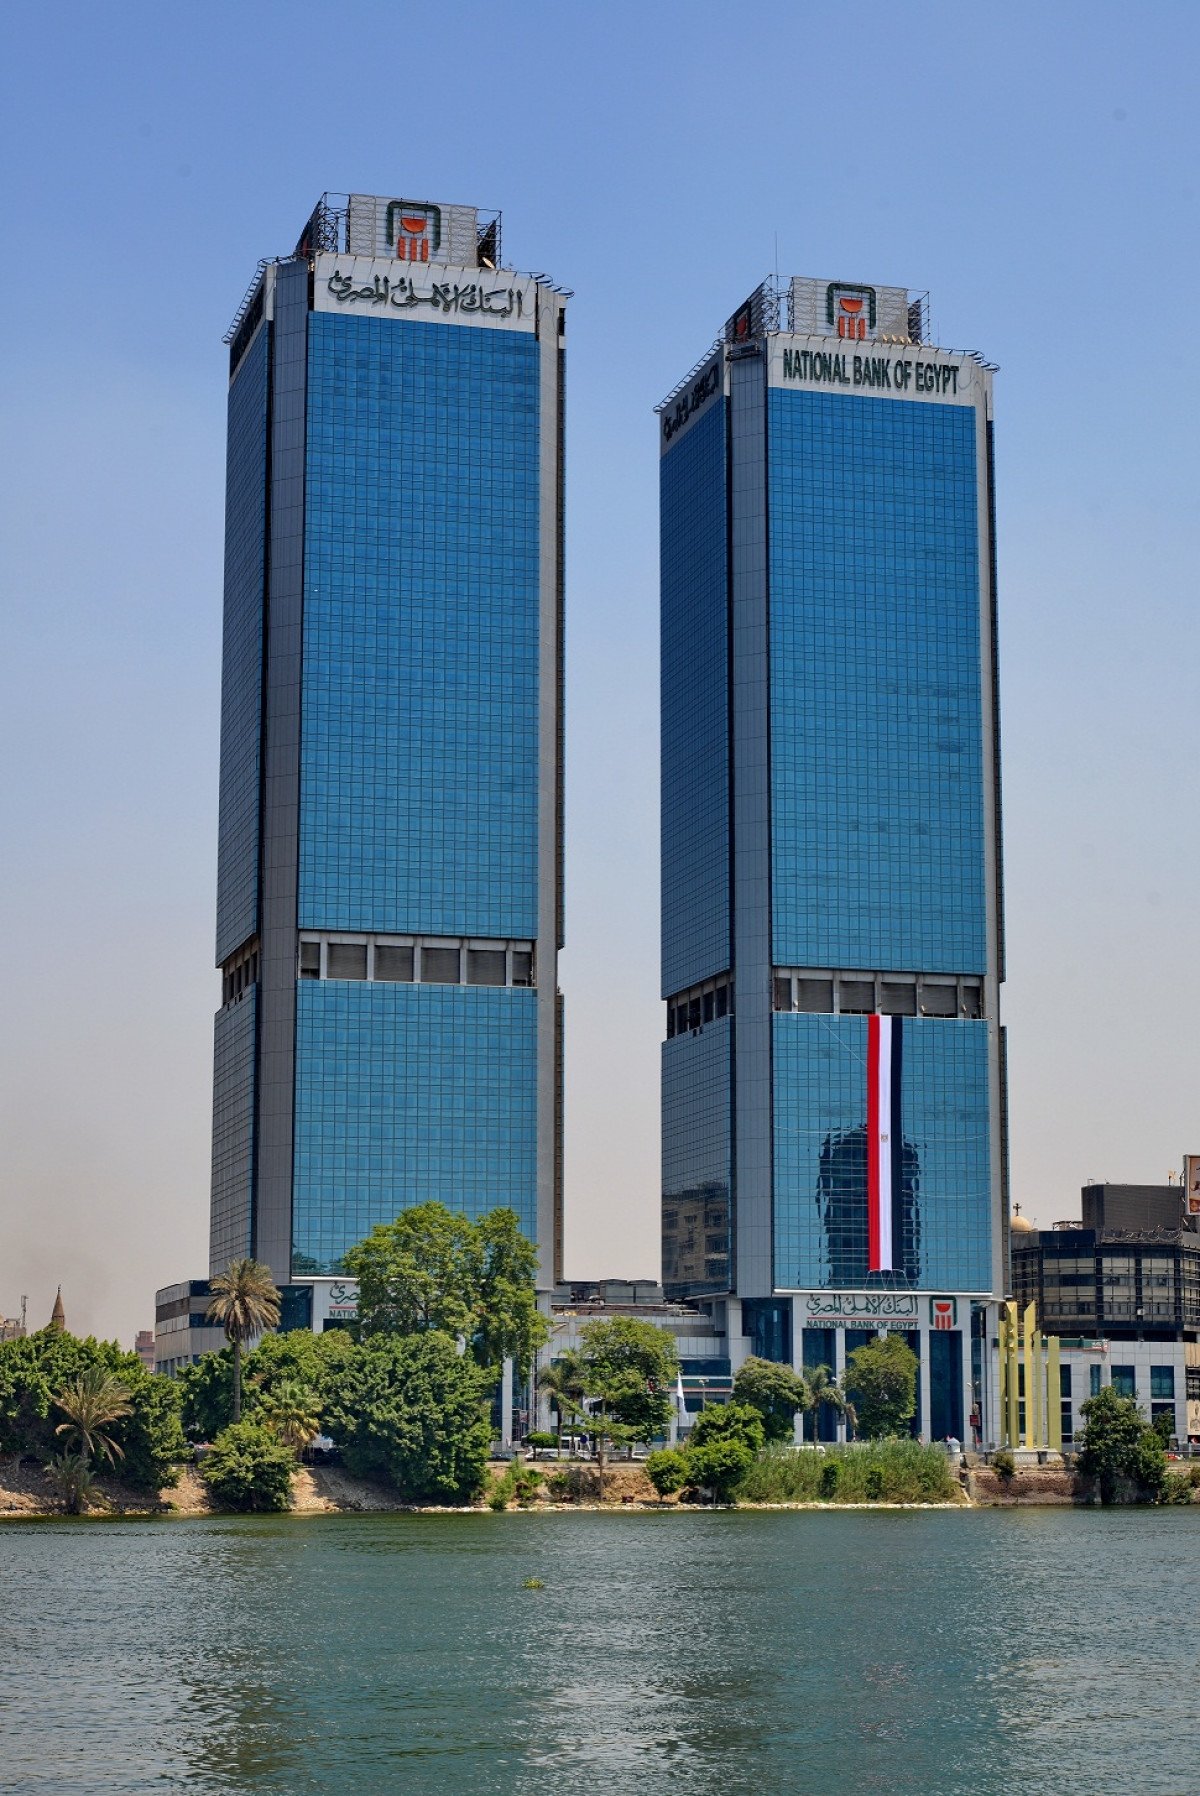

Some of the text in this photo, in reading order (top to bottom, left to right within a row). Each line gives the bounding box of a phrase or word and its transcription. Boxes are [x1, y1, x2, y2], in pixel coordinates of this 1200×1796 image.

[783, 348, 960, 394] NATIONAL BANK OF EGYPT
[807, 1320, 919, 1329] NATIONAL BANK OF EGYPT
